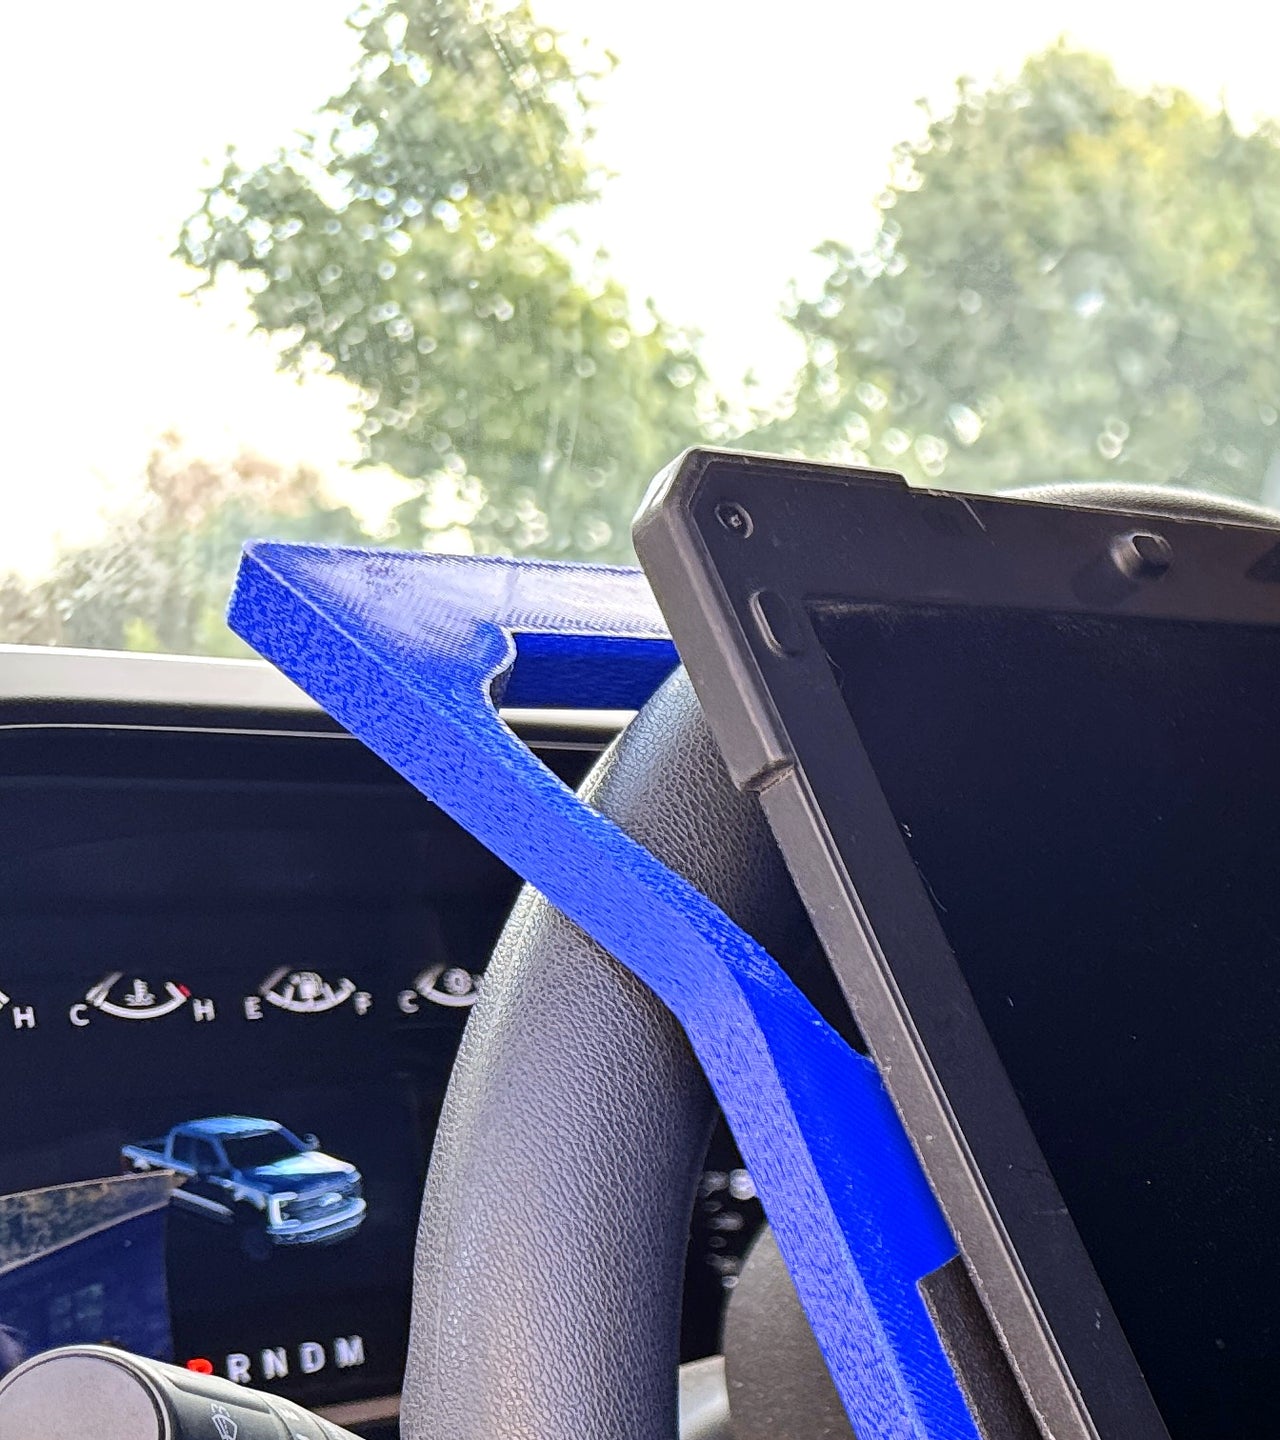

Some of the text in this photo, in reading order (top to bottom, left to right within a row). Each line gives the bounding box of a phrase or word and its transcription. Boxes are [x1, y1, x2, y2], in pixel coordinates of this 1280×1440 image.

[69, 999, 215, 1026] C H
[244, 992, 372, 1020] E F
[397, 990, 419, 1013] C
[13, 1006, 36, 1029] H
[226, 1353, 251, 1383] R
[261, 1346, 289, 1379] N
[299, 1341, 326, 1373] D
[334, 1334, 365, 1369] M
